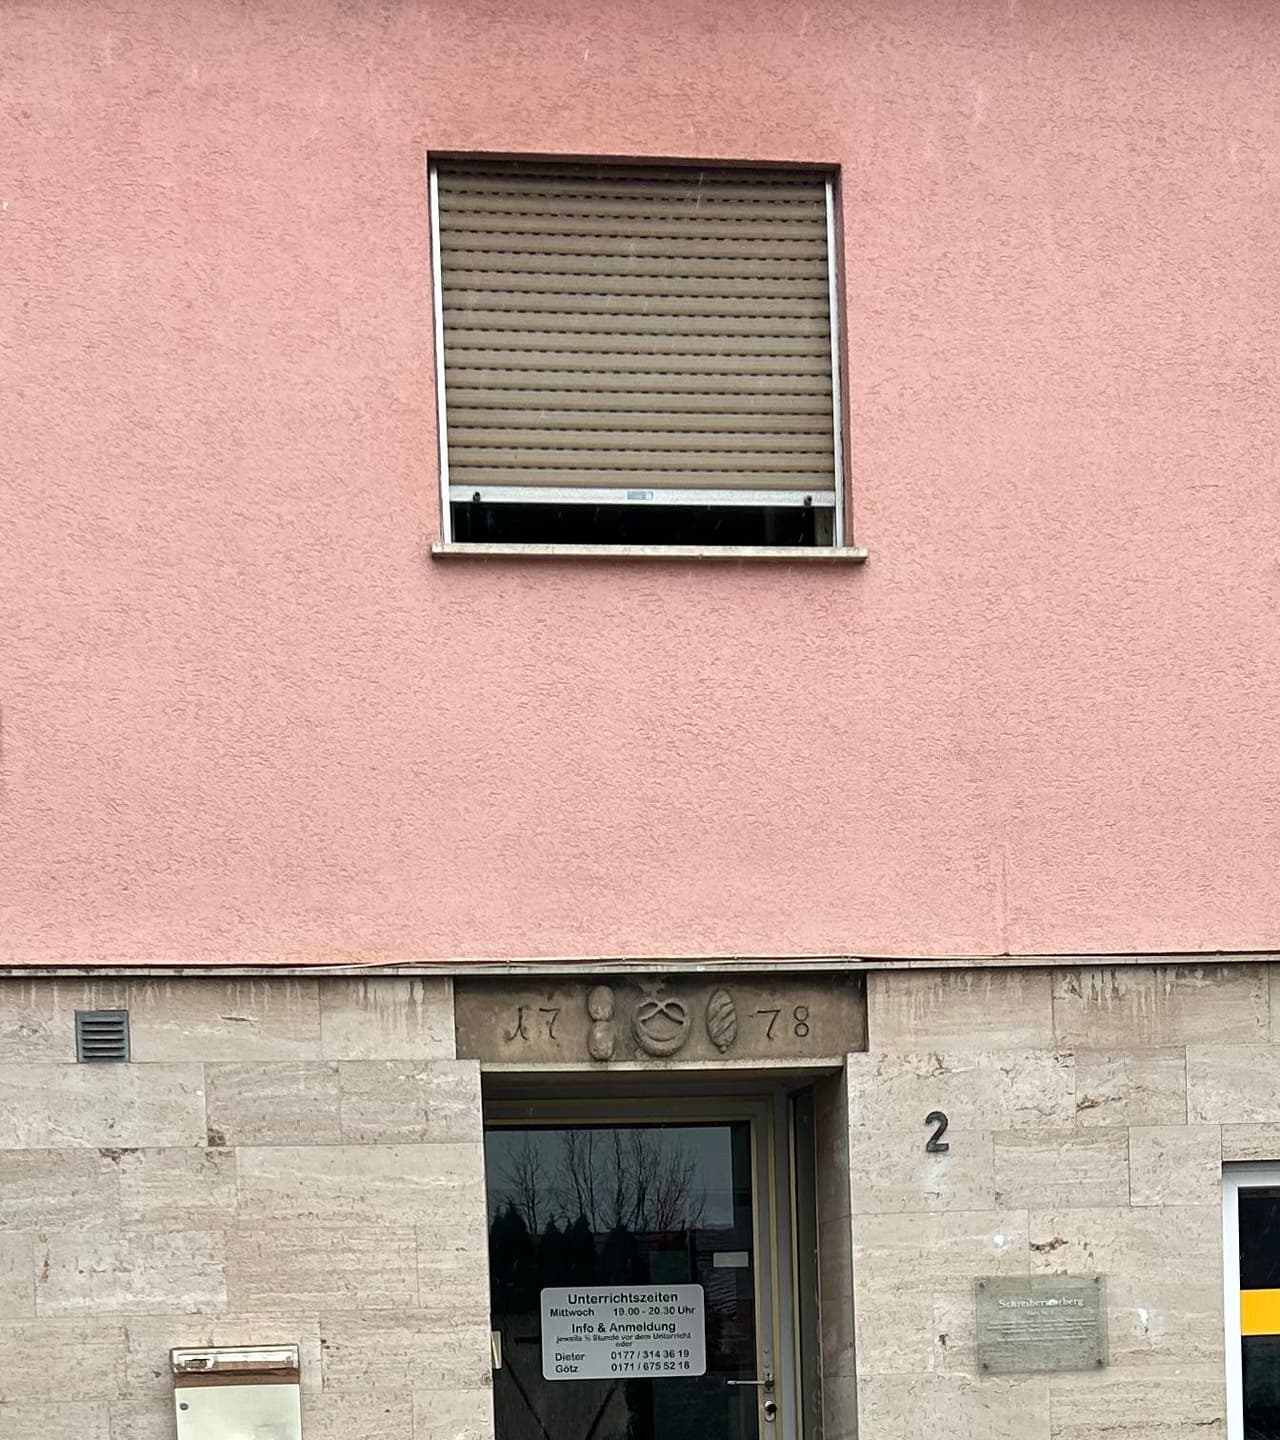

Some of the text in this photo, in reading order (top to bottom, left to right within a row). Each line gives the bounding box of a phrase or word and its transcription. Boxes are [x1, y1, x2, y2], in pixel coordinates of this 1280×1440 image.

[925, 1111, 950, 1154] 2
[568, 1291, 679, 1305] Unterrichtszeiten
[550, 1307, 595, 1318] Mittwoch
[648, 1306, 676, 1316] 20.30
[677, 1305, 696, 1315] Uhr
[572, 1321, 677, 1334] Info & Anmeldung
[556, 1335, 583, 1344] jeweils
[593, 1334, 619, 1342] Stunde
[634, 1333, 651, 1341] dem
[652, 1331, 692, 1341] Unterricht
[615, 1340, 633, 1348] oder
[555, 1353, 586, 1362] Dieter
[610, 1351, 635, 1360] 0177
[643, 1350, 661, 1359] 314
[662, 1349, 676, 1358] 36
[555, 1363, 579, 1374] Götz
[611, 1363, 635, 1372] 0171
[664, 1361, 676, 1370] 52
